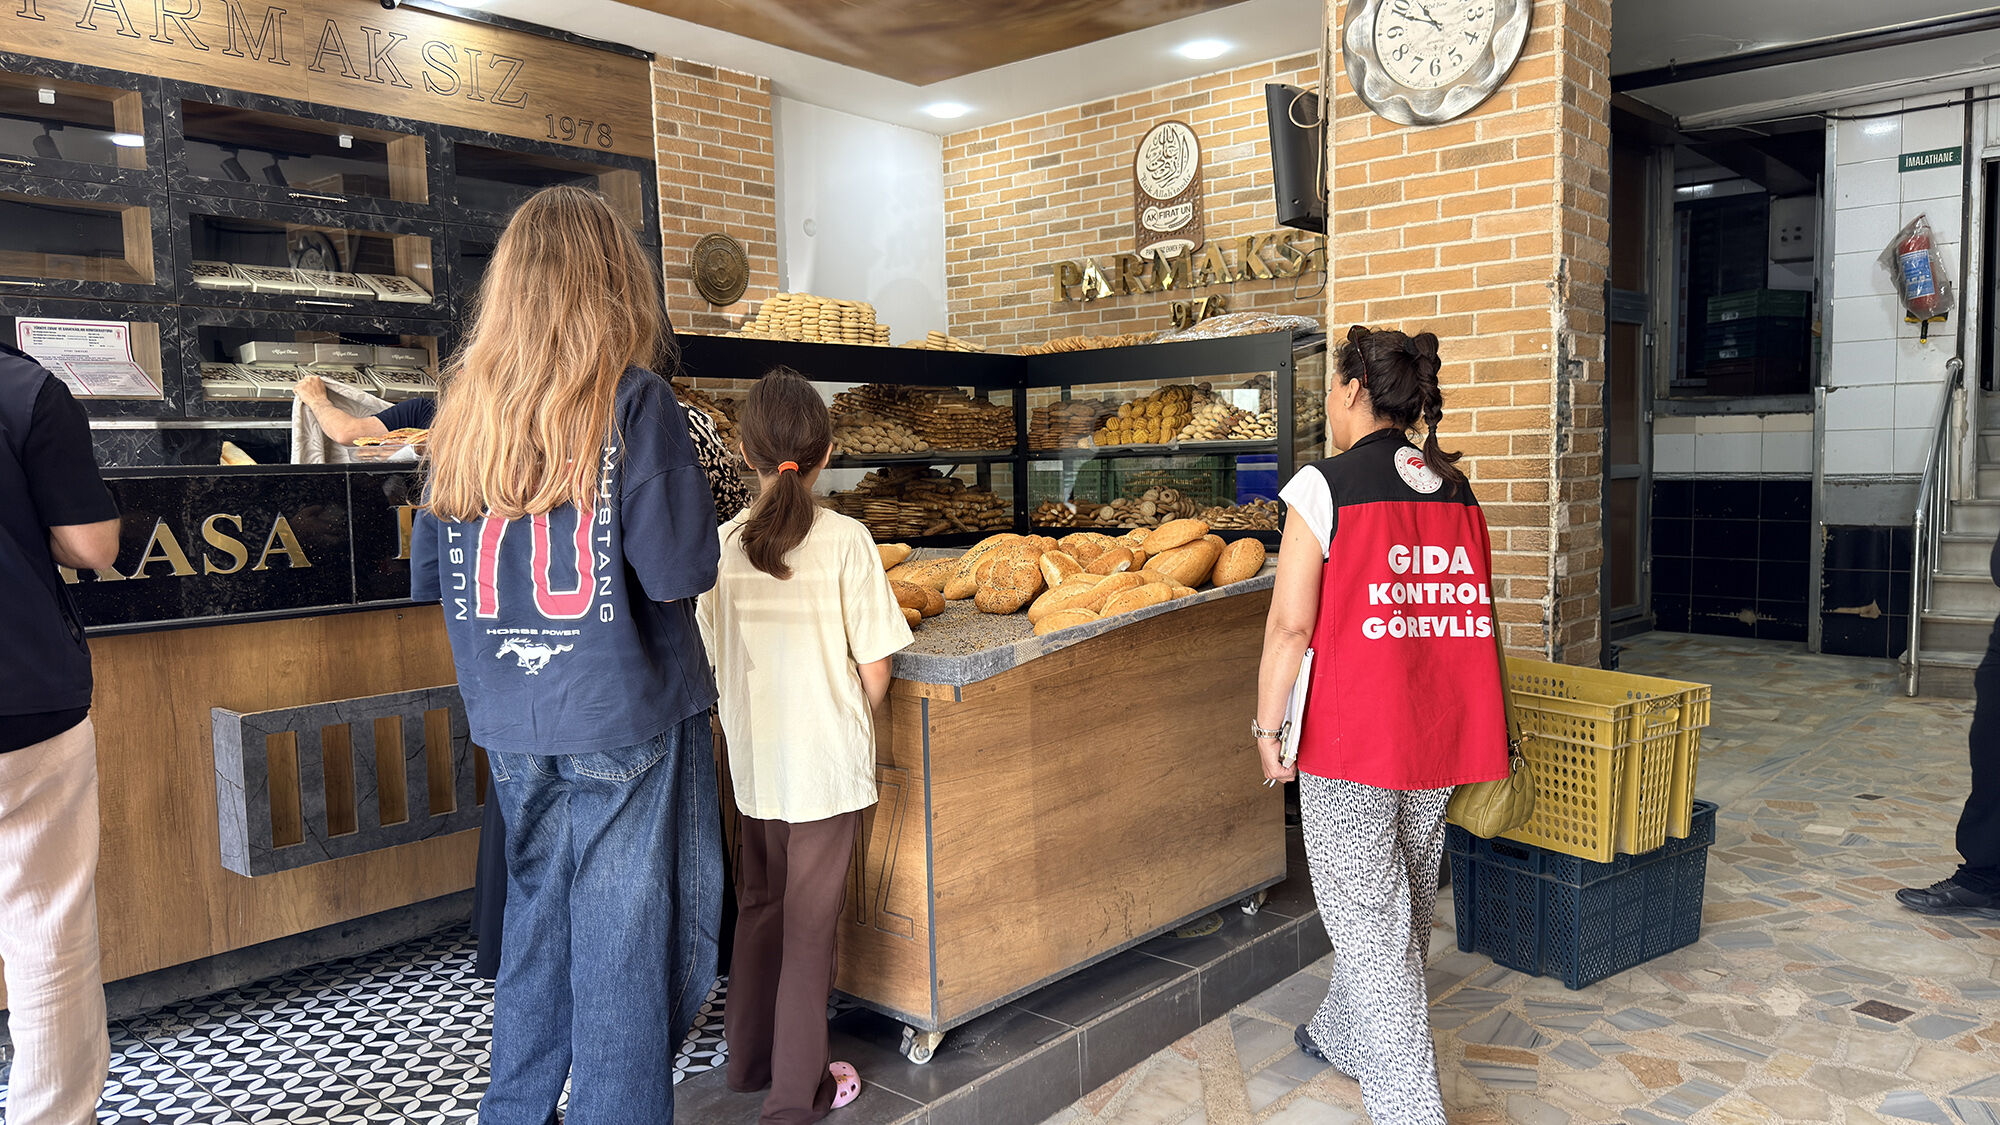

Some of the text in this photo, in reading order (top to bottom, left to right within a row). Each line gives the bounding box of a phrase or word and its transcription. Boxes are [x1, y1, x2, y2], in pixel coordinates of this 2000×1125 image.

[1392, 43, 1409, 61] 8
[1448, 46, 1463, 67] 5
[1409, 55, 1424, 74] 7
[1429, 58, 1441, 77] 6
[545, 114, 614, 149] 1978
[1905, 151, 1954, 168] İMALATHANE
[1146, 204, 1191, 222] AK FIRAT UN
[598, 446, 616, 623] MUSTANG
[58, 511, 312, 585] ASA
[1387, 544, 1474, 575] GIDA
[1368, 582, 1491, 605] KONTROL
[1361, 609, 1495, 640] GÖREVLİS
